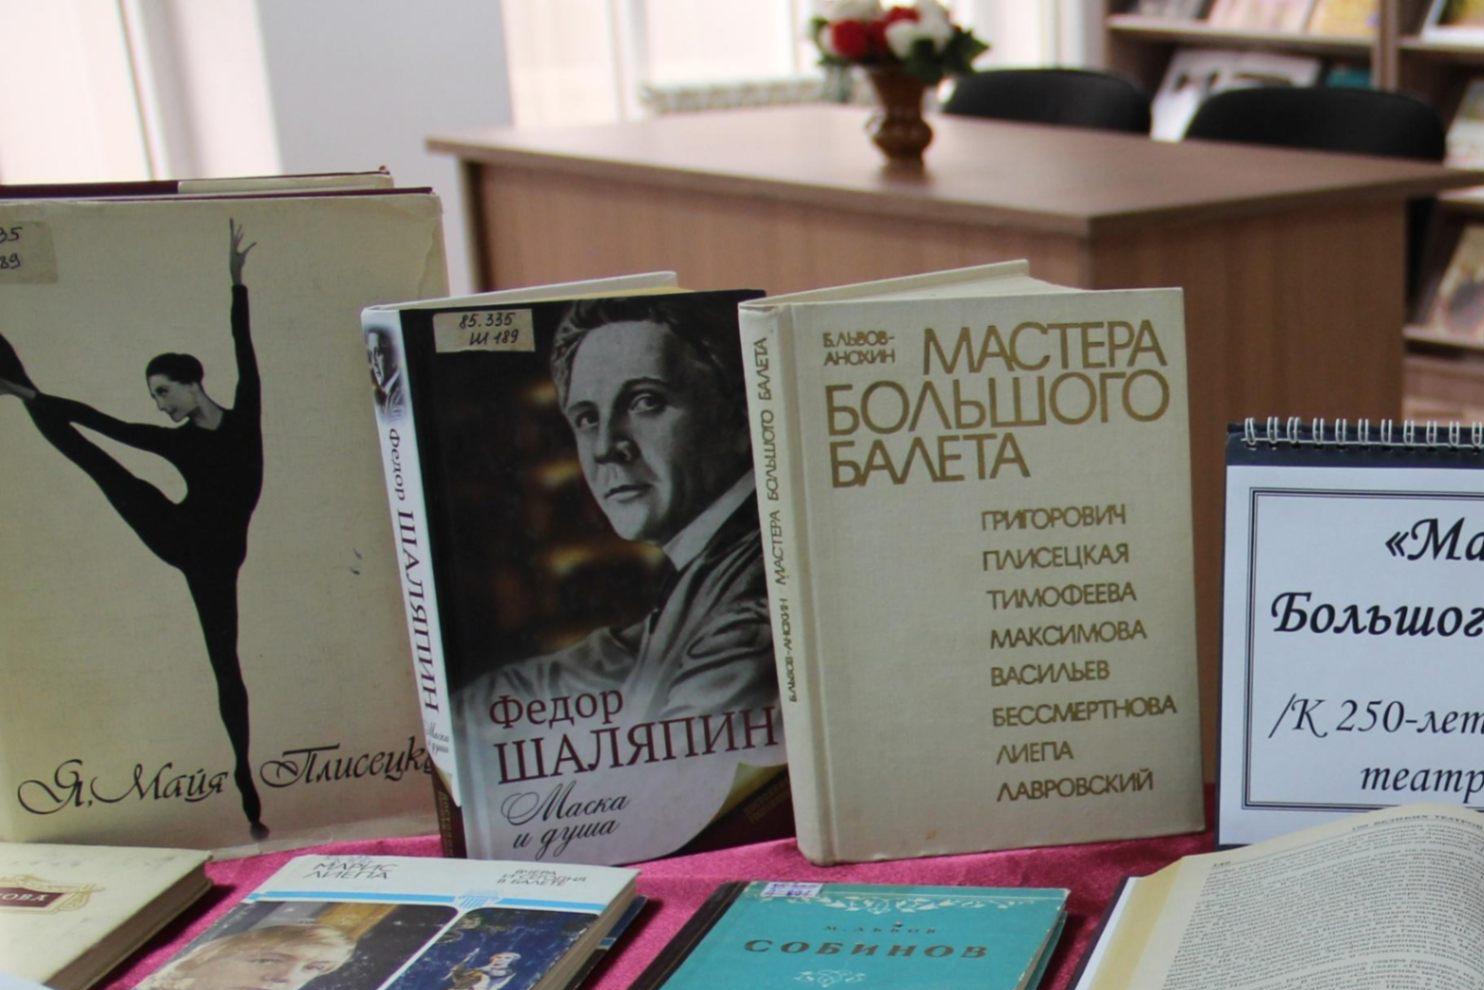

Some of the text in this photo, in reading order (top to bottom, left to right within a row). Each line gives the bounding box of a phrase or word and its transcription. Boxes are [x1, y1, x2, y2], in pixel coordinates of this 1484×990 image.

[824, 349, 895, 366] АНОХИН
[923, 319, 1168, 375] МАСТЕРА
[751, 337, 772, 400] БАЛЕТА
[825, 369, 1170, 436] БОЛЬШОГО
[758, 409, 781, 501] БОЛЬШОГО
[830, 432, 1031, 488] БАЛЕТА
[981, 504, 1127, 531] ГРИГОРОВИЧ
[768, 510, 787, 585] МАСТЕРА
[983, 543, 1130, 571] ПЛИСЕЦКАЯ
[397, 508, 440, 712] ШАЛЯПИН
[987, 582, 1137, 610] ТИМОФЕЕВА
[990, 620, 1147, 649] МАКСИМОВА
[991, 661, 1110, 687] ВАСИЛЬЕВ
[489, 689, 624, 729] Федор
[992, 695, 1177, 727] БЕССМЕРТНОВА
[1269, 694, 1327, 738] /К
[494, 706, 778, 785] ШАЛЯПИН
[996, 741, 1074, 764] ЛИЕПА
[91, 763, 228, 803] Майя
[500, 781, 627, 825] Маска
[996, 768, 1154, 802] ЛАВРОВСКИЙ
[513, 820, 621, 861] и душа
[744, 939, 988, 958] СОБИНОВ
